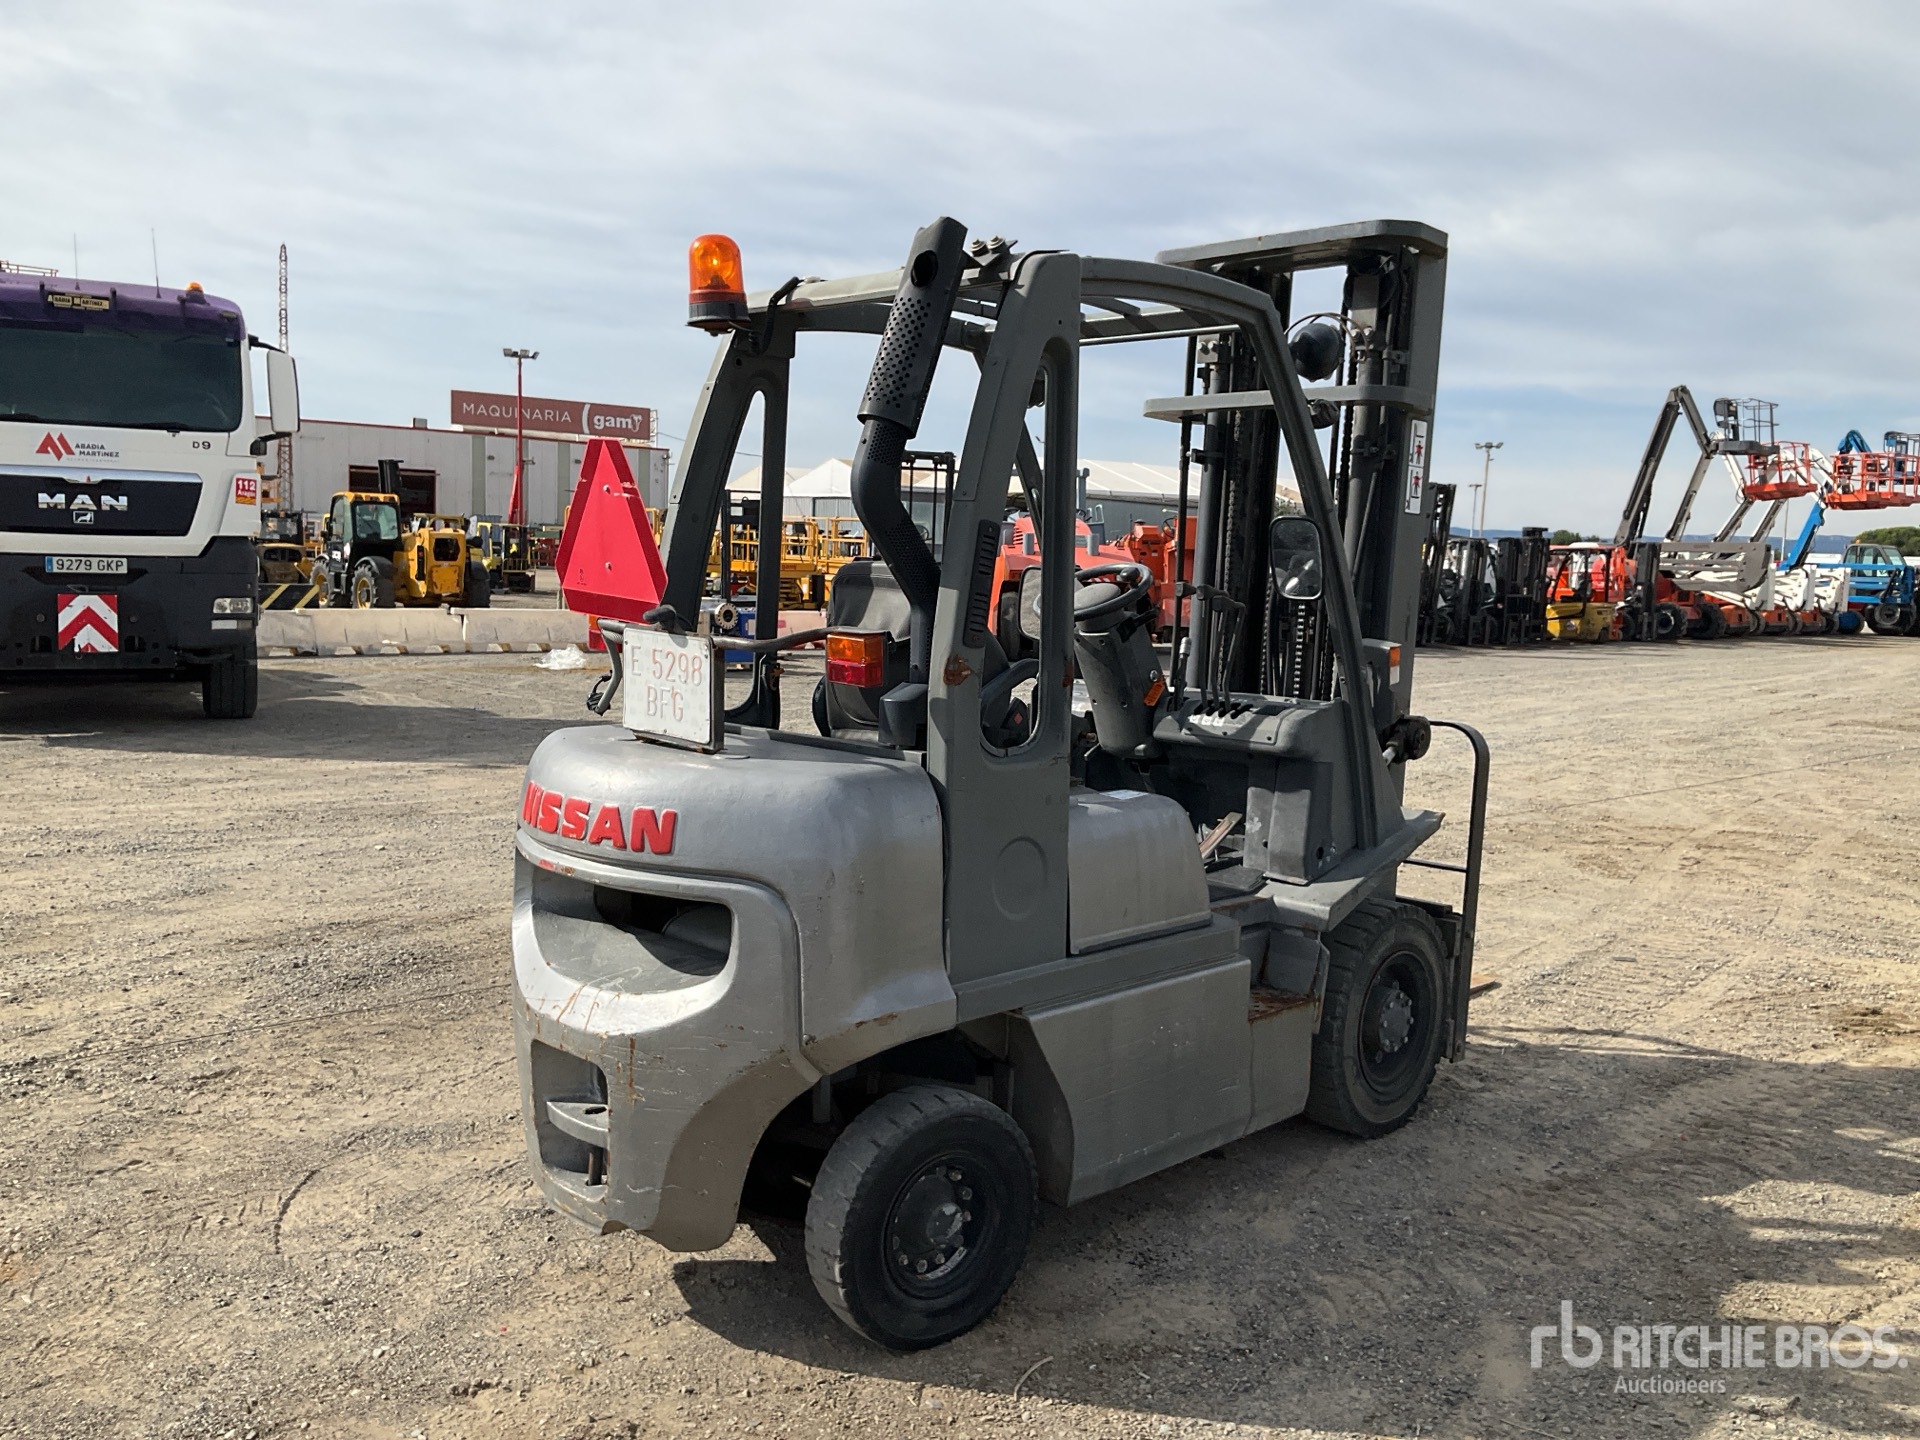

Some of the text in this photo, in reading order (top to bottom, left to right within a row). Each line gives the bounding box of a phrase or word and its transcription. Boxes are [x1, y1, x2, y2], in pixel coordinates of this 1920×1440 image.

[462, 402, 572, 423] MAQUINARIA
[237, 479, 256, 491] 112
[38, 492, 128, 511] MAN
[56, 558, 124, 572] 9279 GKP
[630, 644, 703, 687] E 5298
[646, 684, 685, 723] BFG
[522, 780, 678, 855] NISSAN
